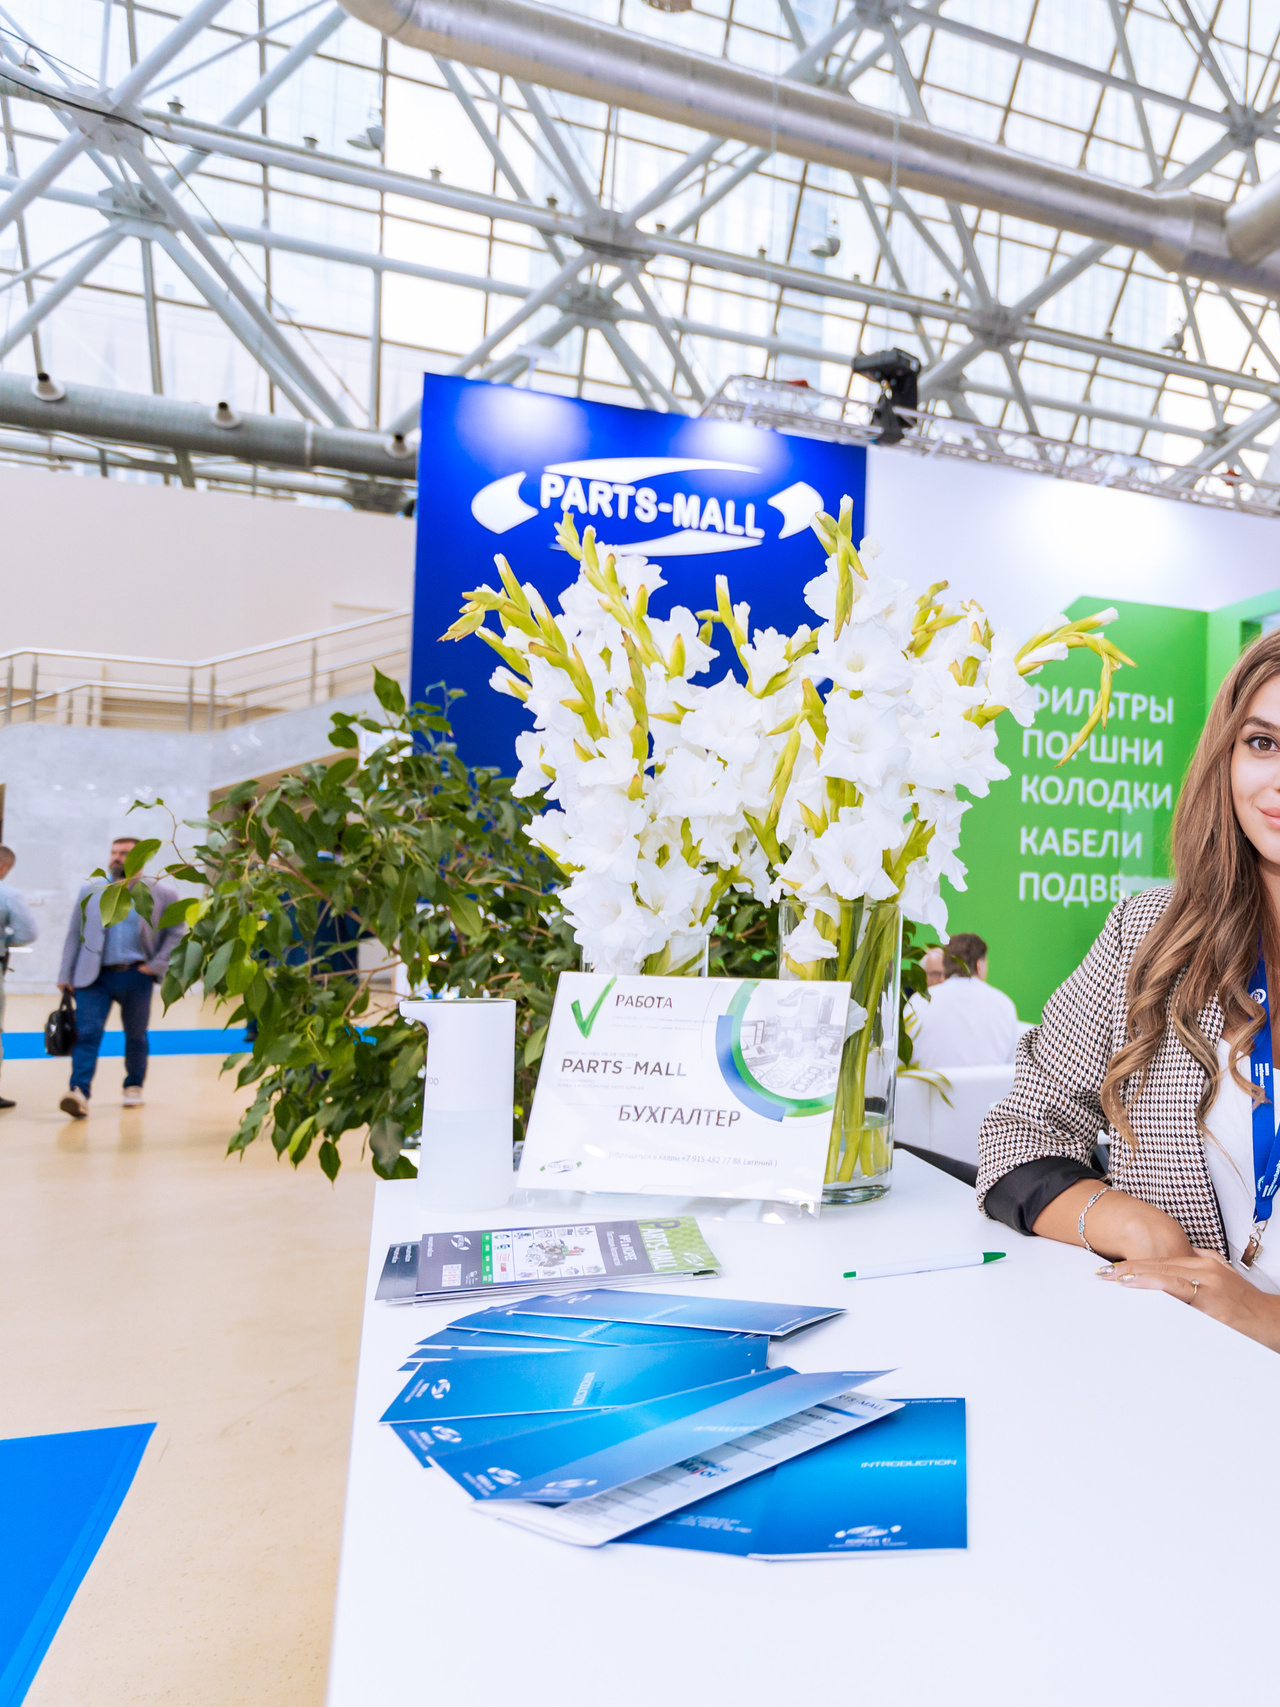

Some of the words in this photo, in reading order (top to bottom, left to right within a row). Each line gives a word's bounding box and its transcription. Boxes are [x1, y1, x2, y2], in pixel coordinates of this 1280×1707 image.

[540, 473, 765, 538] PARTS-MALL
[1021, 774, 1173, 813] КОЛОДКИ
[1020, 826, 1143, 858] КАБЕЛИ
[1019, 871, 1130, 908] ПОДВЕ
[615, 993, 673, 1009] РАБОТА
[561, 1057, 687, 1077] PARTS-MALL
[618, 1105, 741, 1127] БУХГАЛТЕР
[691, 1154, 706, 1164] 915
[861, 1459, 957, 1468] INTRODUCTION
